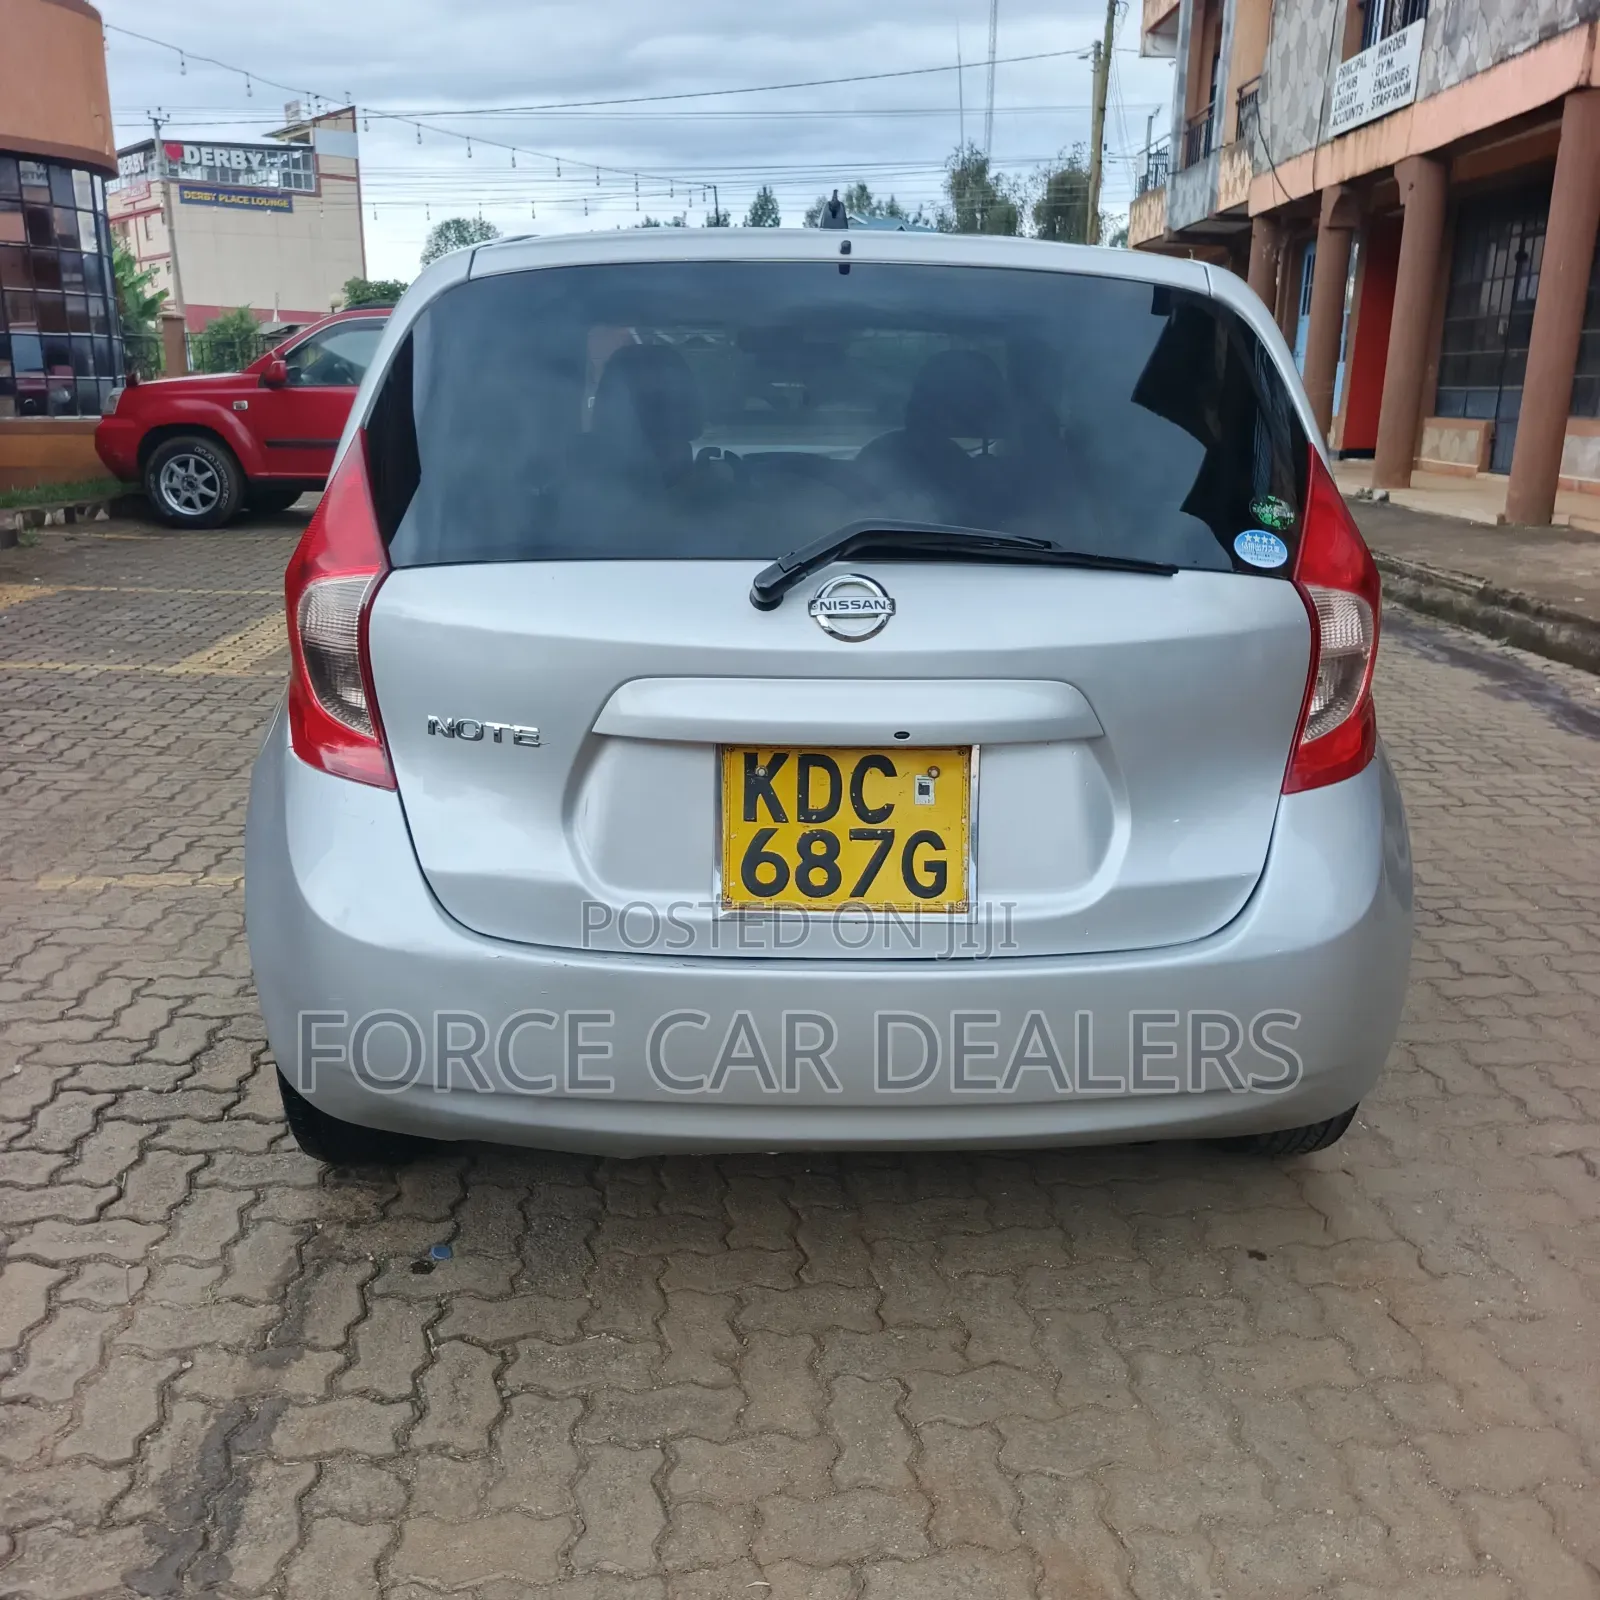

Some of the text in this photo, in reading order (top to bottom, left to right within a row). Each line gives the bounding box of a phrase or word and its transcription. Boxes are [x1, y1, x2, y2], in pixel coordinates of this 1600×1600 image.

[1378, 32, 1408, 59] WARDEN
[1373, 64, 1411, 93] ENQUIRIES
[1332, 102, 1365, 127] ACCOUNTS
[1334, 90, 1359, 112] LIBRARY
[183, 144, 263, 171] DERBY
[183, 190, 290, 208] DERBY PLACE LOUNGE
[819, 599, 886, 612] NISSAN
[427, 714, 541, 748] NOTE
[743, 751, 898, 825] KDC
[740, 827, 948, 899] 687G
